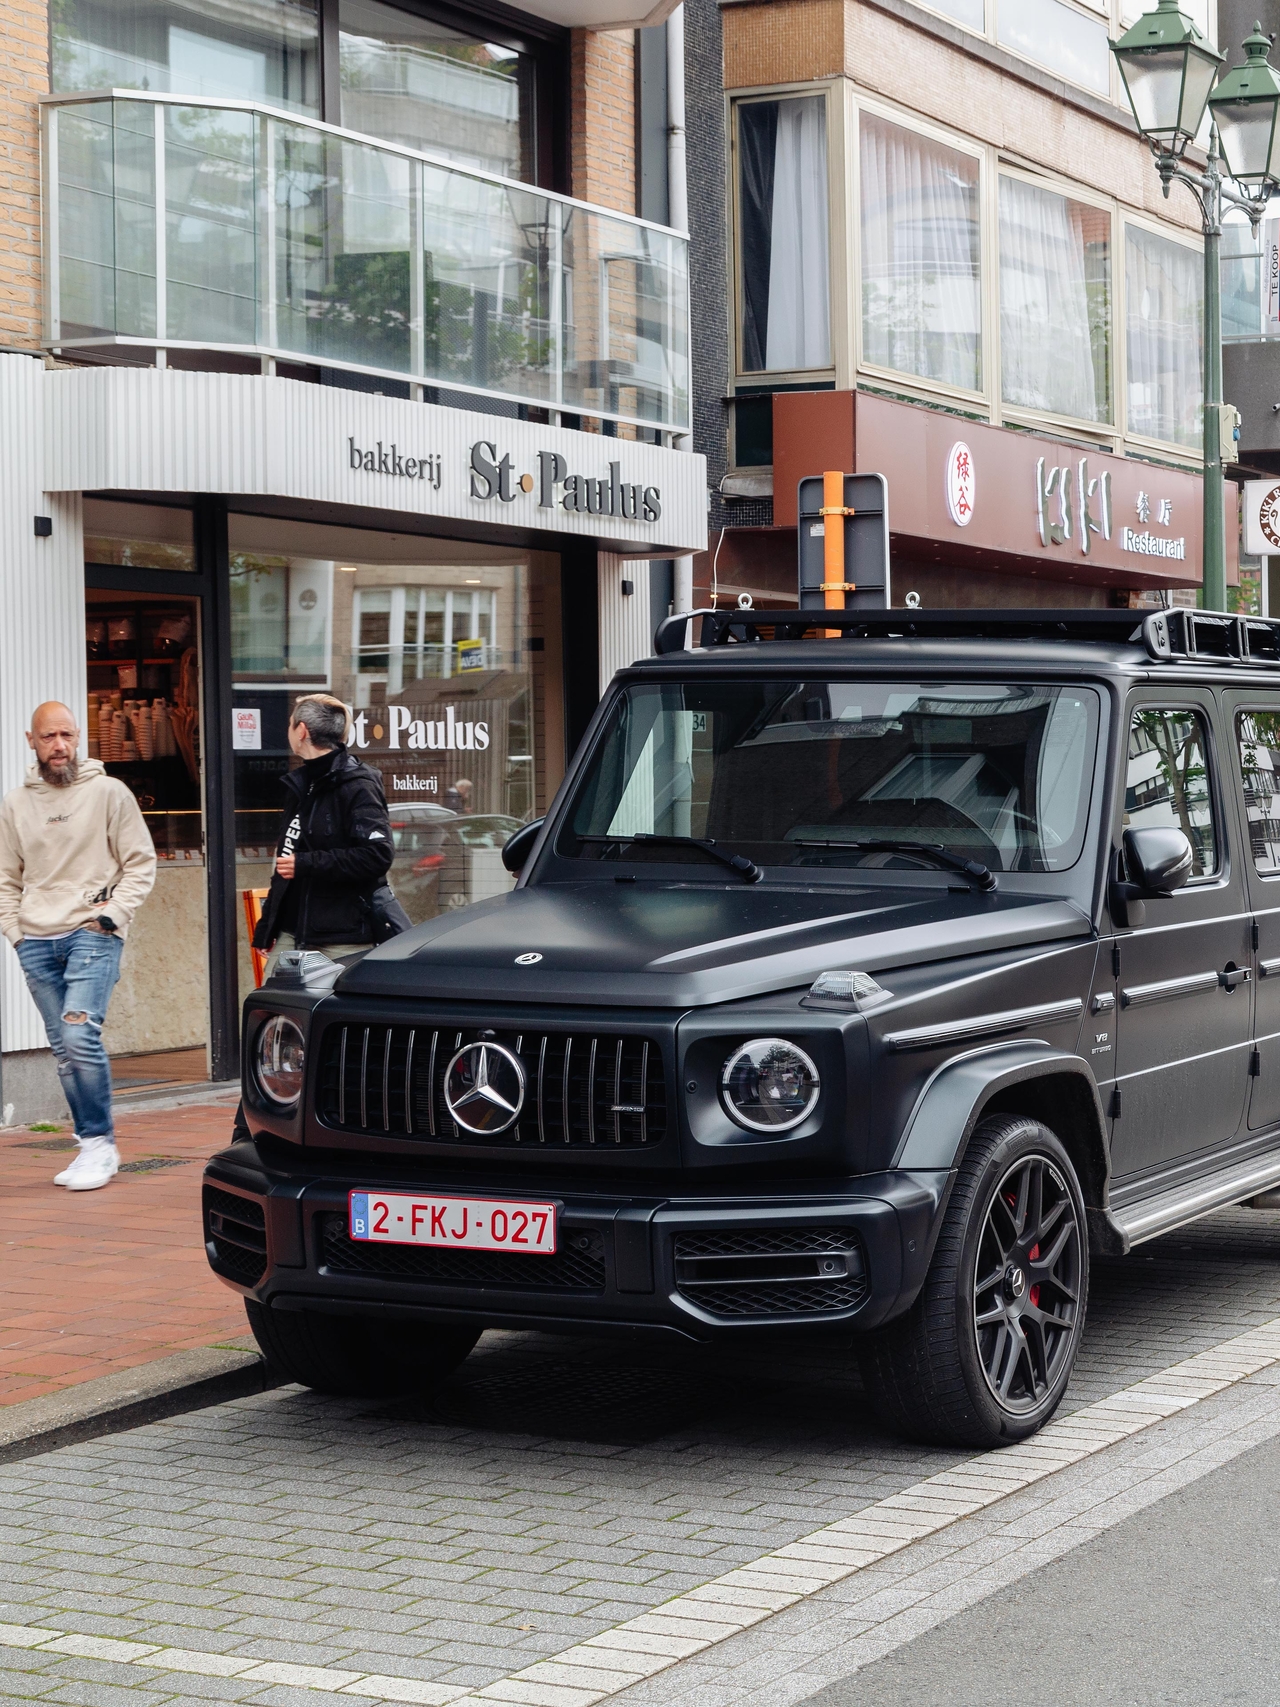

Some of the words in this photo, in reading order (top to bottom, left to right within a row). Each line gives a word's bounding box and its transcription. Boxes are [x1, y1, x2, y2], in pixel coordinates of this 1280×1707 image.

[1272, 282, 1278, 296] TE
[348, 437, 442, 490] bakkerij
[537, 450, 662, 523] Paulus
[1123, 526, 1186, 560] Restaurant
[388, 705, 490, 750] Paulus
[693, 714, 705, 730] 34
[392, 774, 438, 794] bakkerij
[1095, 1033, 1108, 1042] V8
[355, 1218, 365, 1234] B
[372, 1202, 548, 1244] 2-FKJ-027
